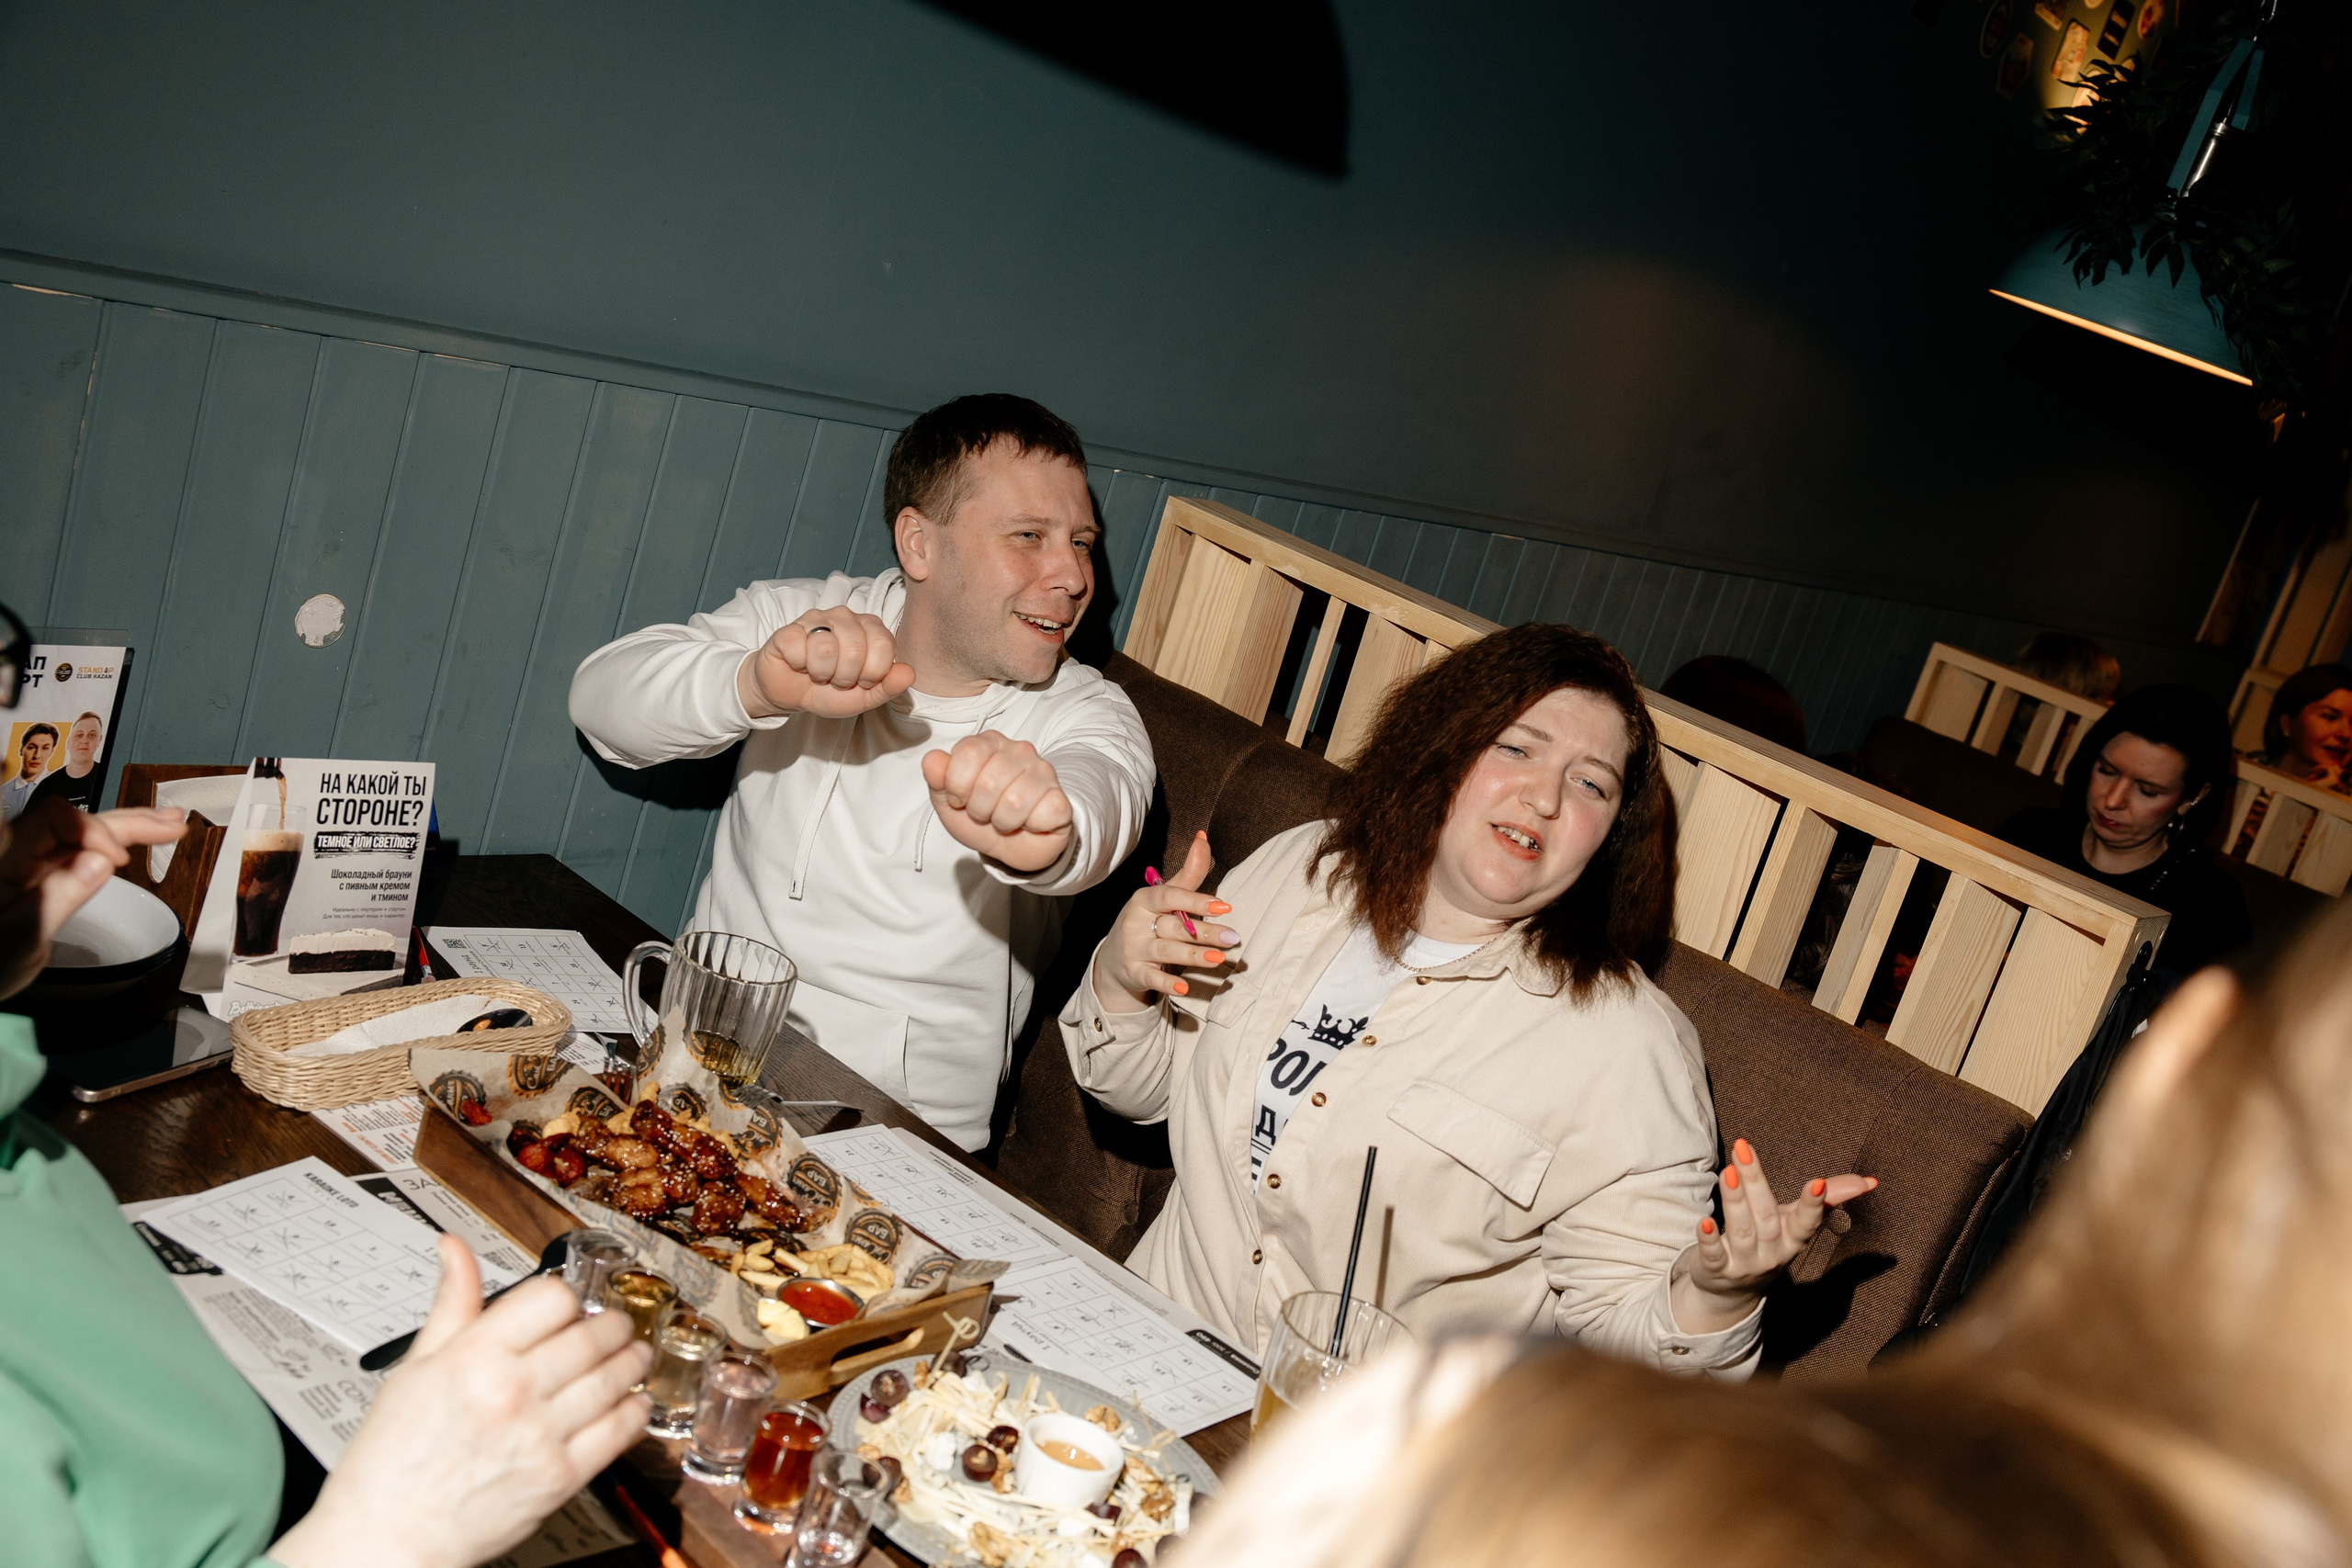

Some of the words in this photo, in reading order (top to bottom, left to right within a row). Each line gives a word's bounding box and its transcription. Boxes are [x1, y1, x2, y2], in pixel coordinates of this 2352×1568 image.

[320, 773, 341, 794] НА
[346, 770, 399, 795] КАКОЙ
[404, 775, 426, 795] ТЫ
[316, 797, 424, 826] СТОРОНЕ?
[317, 835, 353, 848] ТЕМНОЕ
[353, 836, 373, 848] ИЛИ
[373, 836, 416, 849] СВЕТЛОЕ?
[331, 869, 384, 880] Шоколадный
[385, 869, 413, 881] брауни
[345, 882, 378, 890] пивным
[379, 882, 410, 891] кремом
[805, 1168, 828, 1187] БАР
[304, 1173, 341, 1196] KARAOKE
[336, 1195, 359, 1208] LOTO
[865, 1221, 889, 1239] БАР
